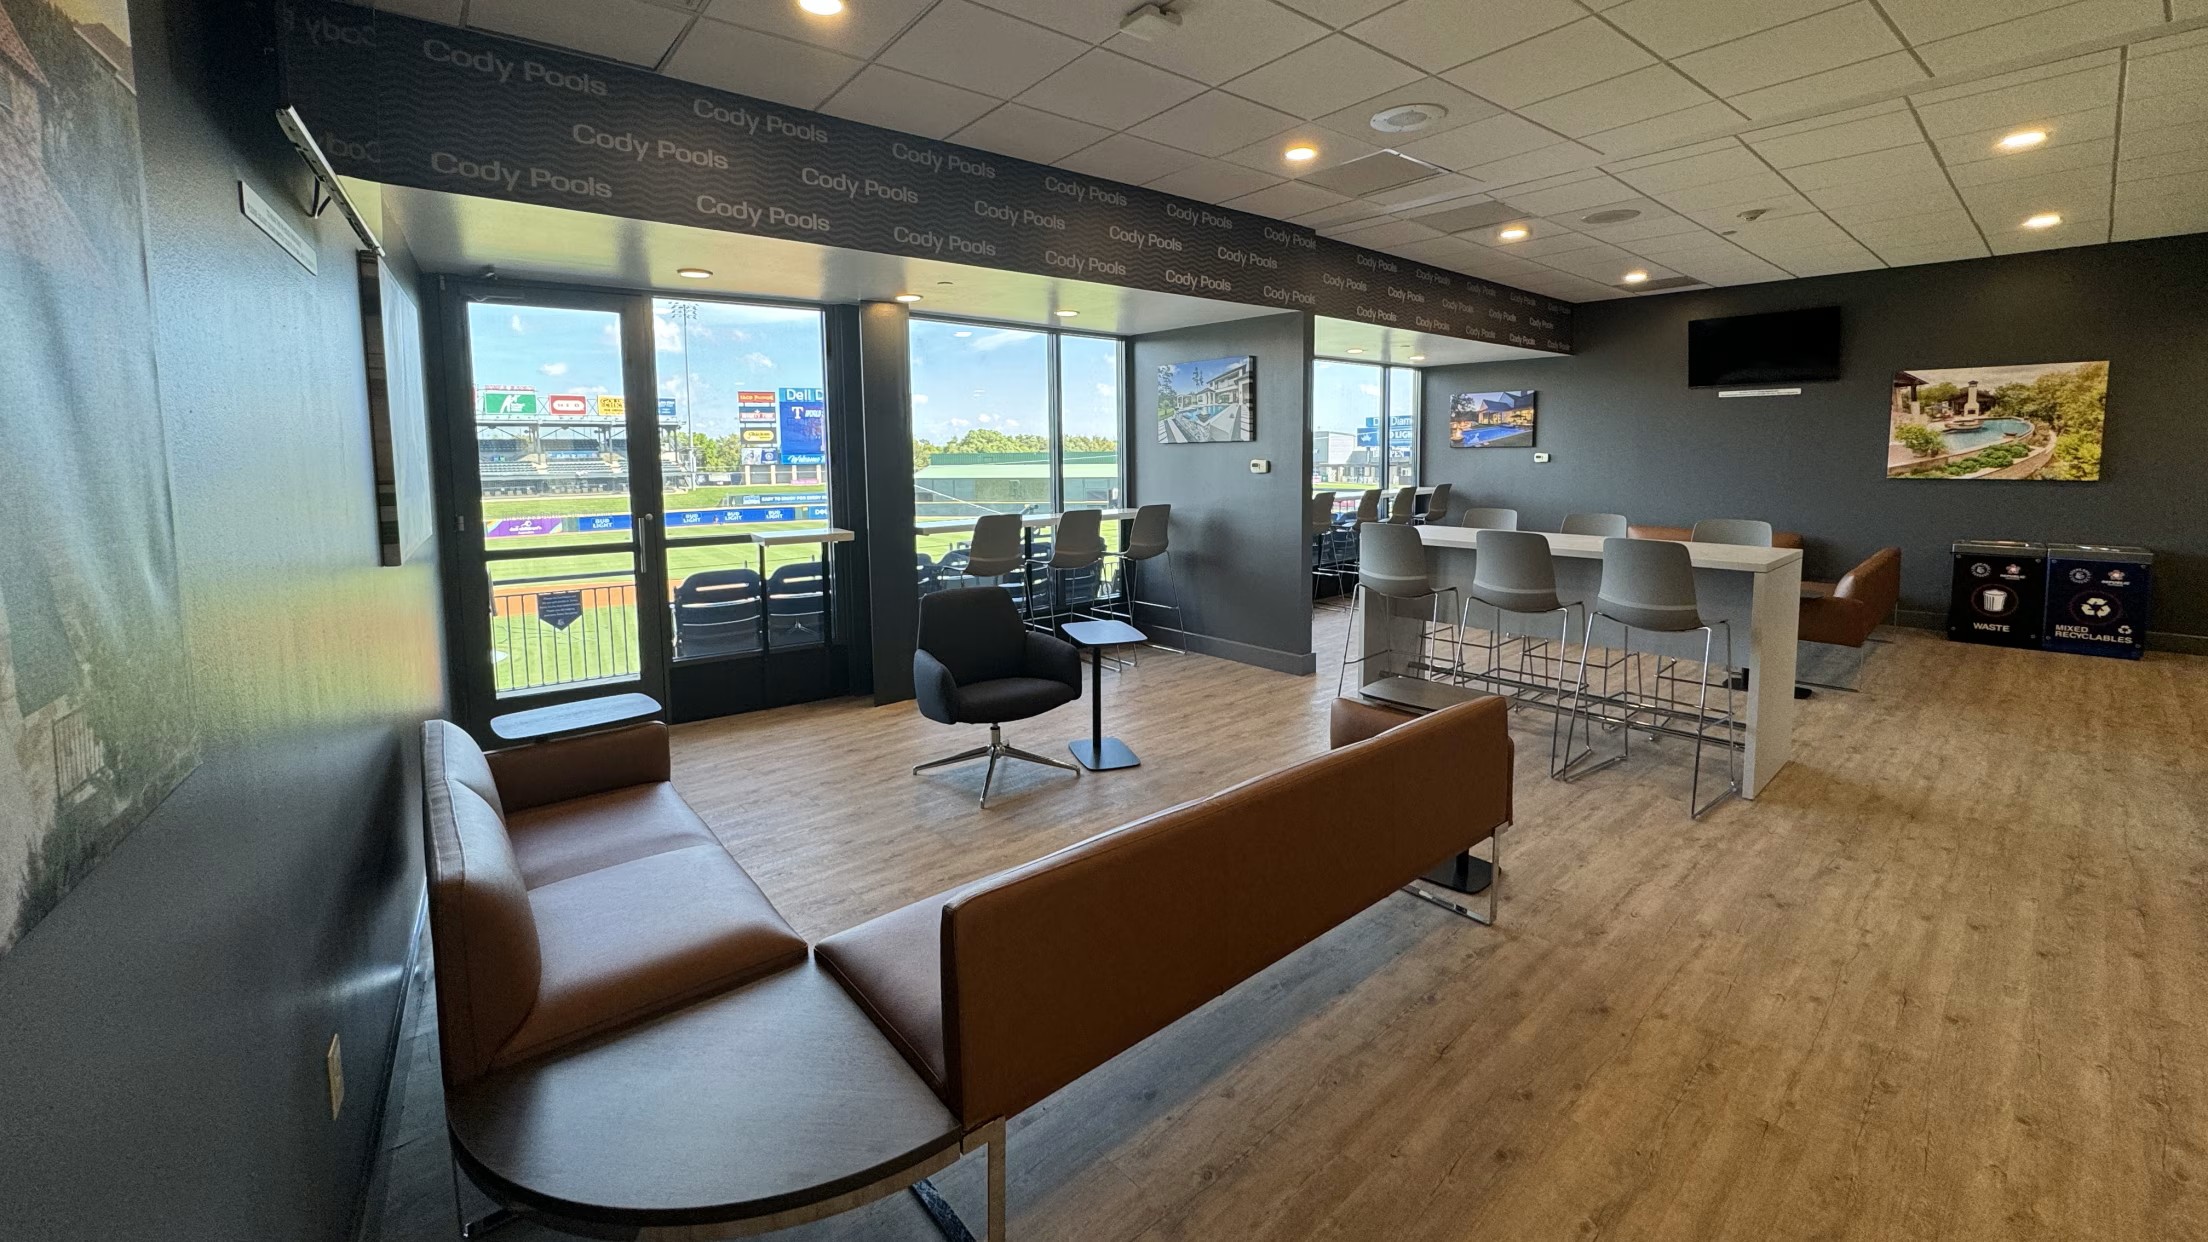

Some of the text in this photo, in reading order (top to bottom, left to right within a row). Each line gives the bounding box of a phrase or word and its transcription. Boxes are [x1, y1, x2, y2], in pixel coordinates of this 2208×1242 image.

[424, 39, 608, 96] Cody Pools
[693, 99, 828, 143] Cody Pools
[573, 124, 728, 170] Cody Pools
[892, 142, 996, 179] Cody Pools
[431, 151, 612, 198] Cody Pools
[801, 167, 918, 204] Cody Pools
[1045, 176, 1127, 207] Cody Pools
[696, 195, 830, 231] Cody Pools
[974, 200, 1066, 230] Cody Pools
[1166, 203, 1232, 230] Cody Pools
[893, 226, 996, 257] Cody Pools
[1109, 225, 1183, 252] Cody Pools
[1264, 226, 1290, 247] Cody
[1045, 250, 1127, 276] Cody Pools
[1217, 246, 1278, 269] Cody Pools
[1357, 254, 1397, 273] Cody Pools
[1165, 269, 1231, 292] Cody Pools
[1322, 273, 1367, 292] Cody Pools
[1263, 285, 1290, 305] Cody
[1388, 286, 1424, 303] Cody Pools
[1442, 298, 1473, 314] Cody Pools
[1356, 305, 1397, 322] Cody Pools
[1416, 316, 1450, 331] Cody Pools
[1465, 325, 1496, 339] Cody Pools
[786, 389, 811, 401] Dell
[1973, 622, 2011, 633] WASTE
[2055, 624, 2088, 633] MIXED
[2055, 631, 2132, 644] RECYCLABLES
